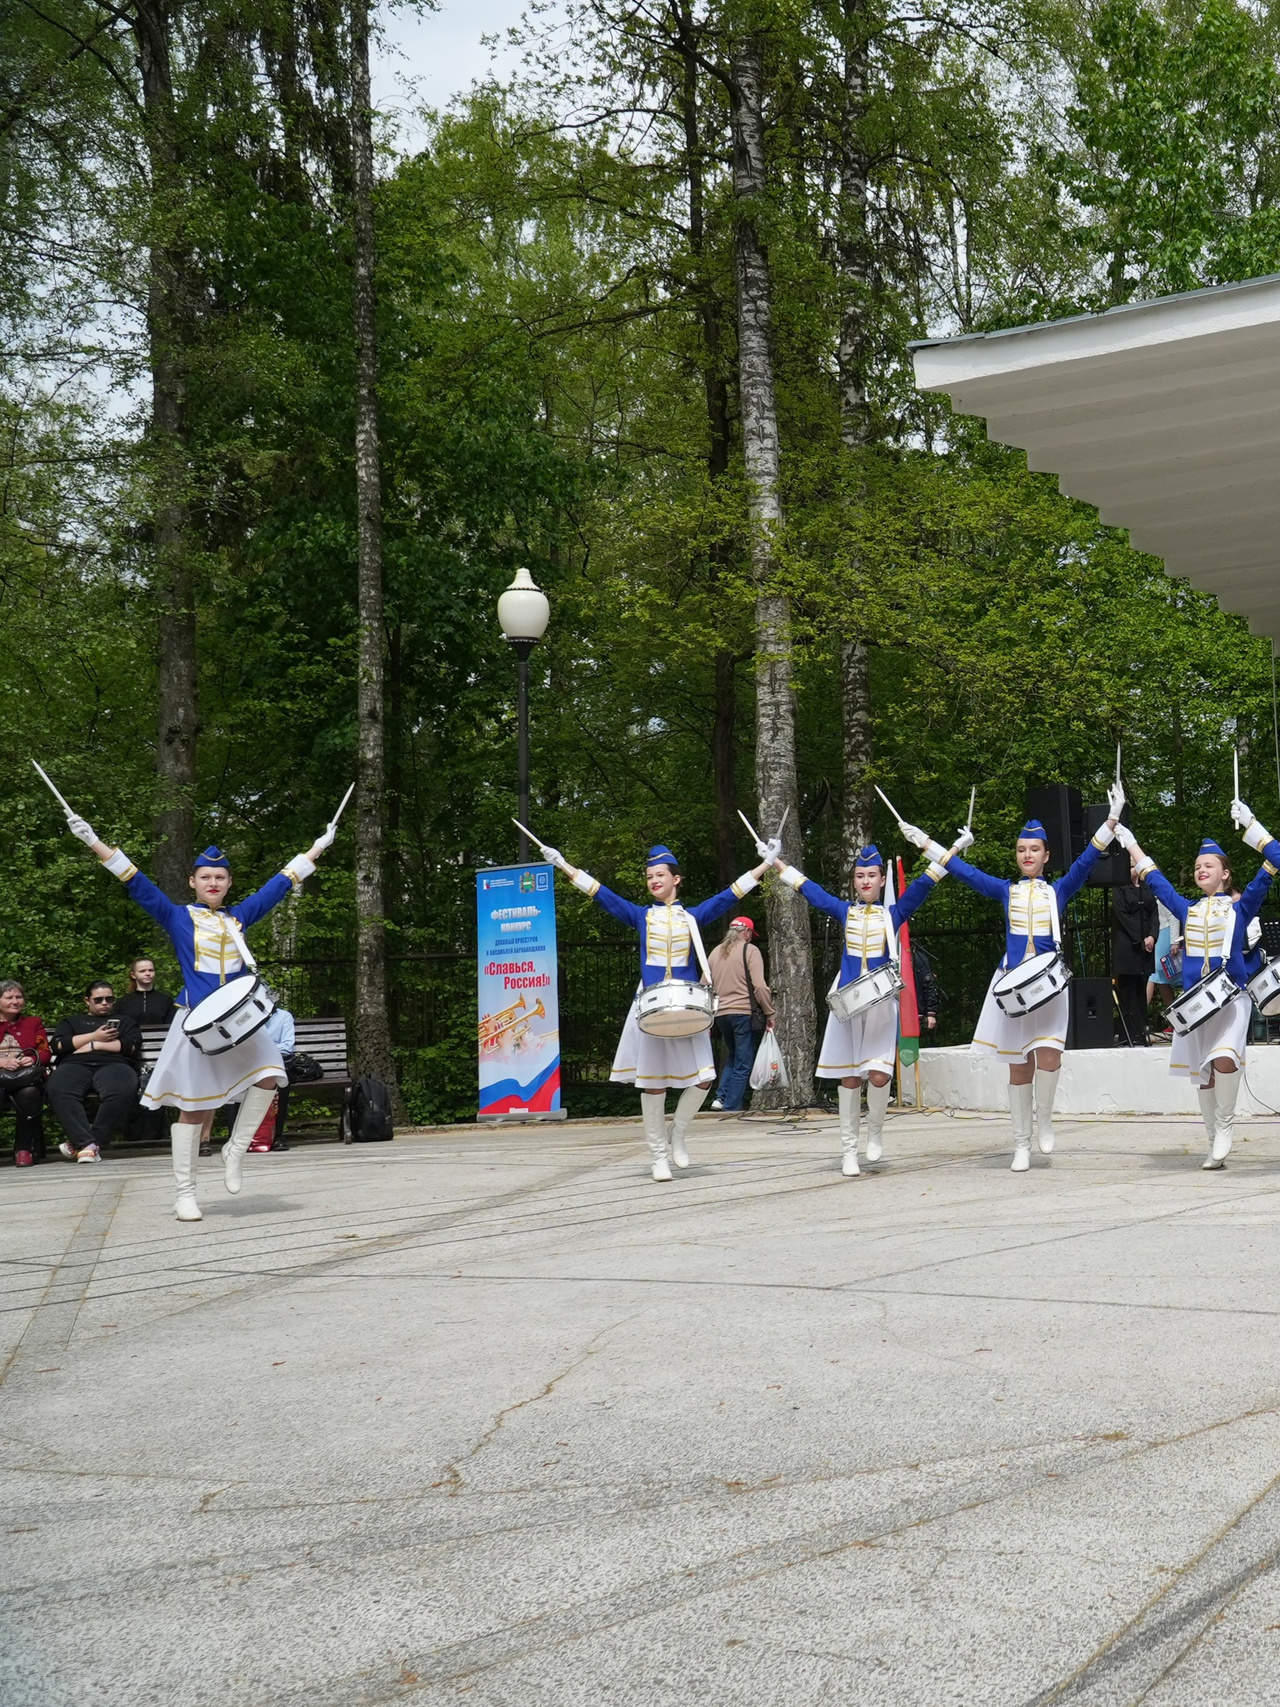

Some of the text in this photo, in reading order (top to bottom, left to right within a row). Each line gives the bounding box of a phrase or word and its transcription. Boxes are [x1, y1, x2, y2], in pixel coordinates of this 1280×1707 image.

[491, 905, 541, 920] ФЕСТИВАЛЬ-
[501, 921, 531, 933] КОНКУРС
[484, 961, 536, 975] «Славься,
[504, 973, 550, 990] Россия!»
